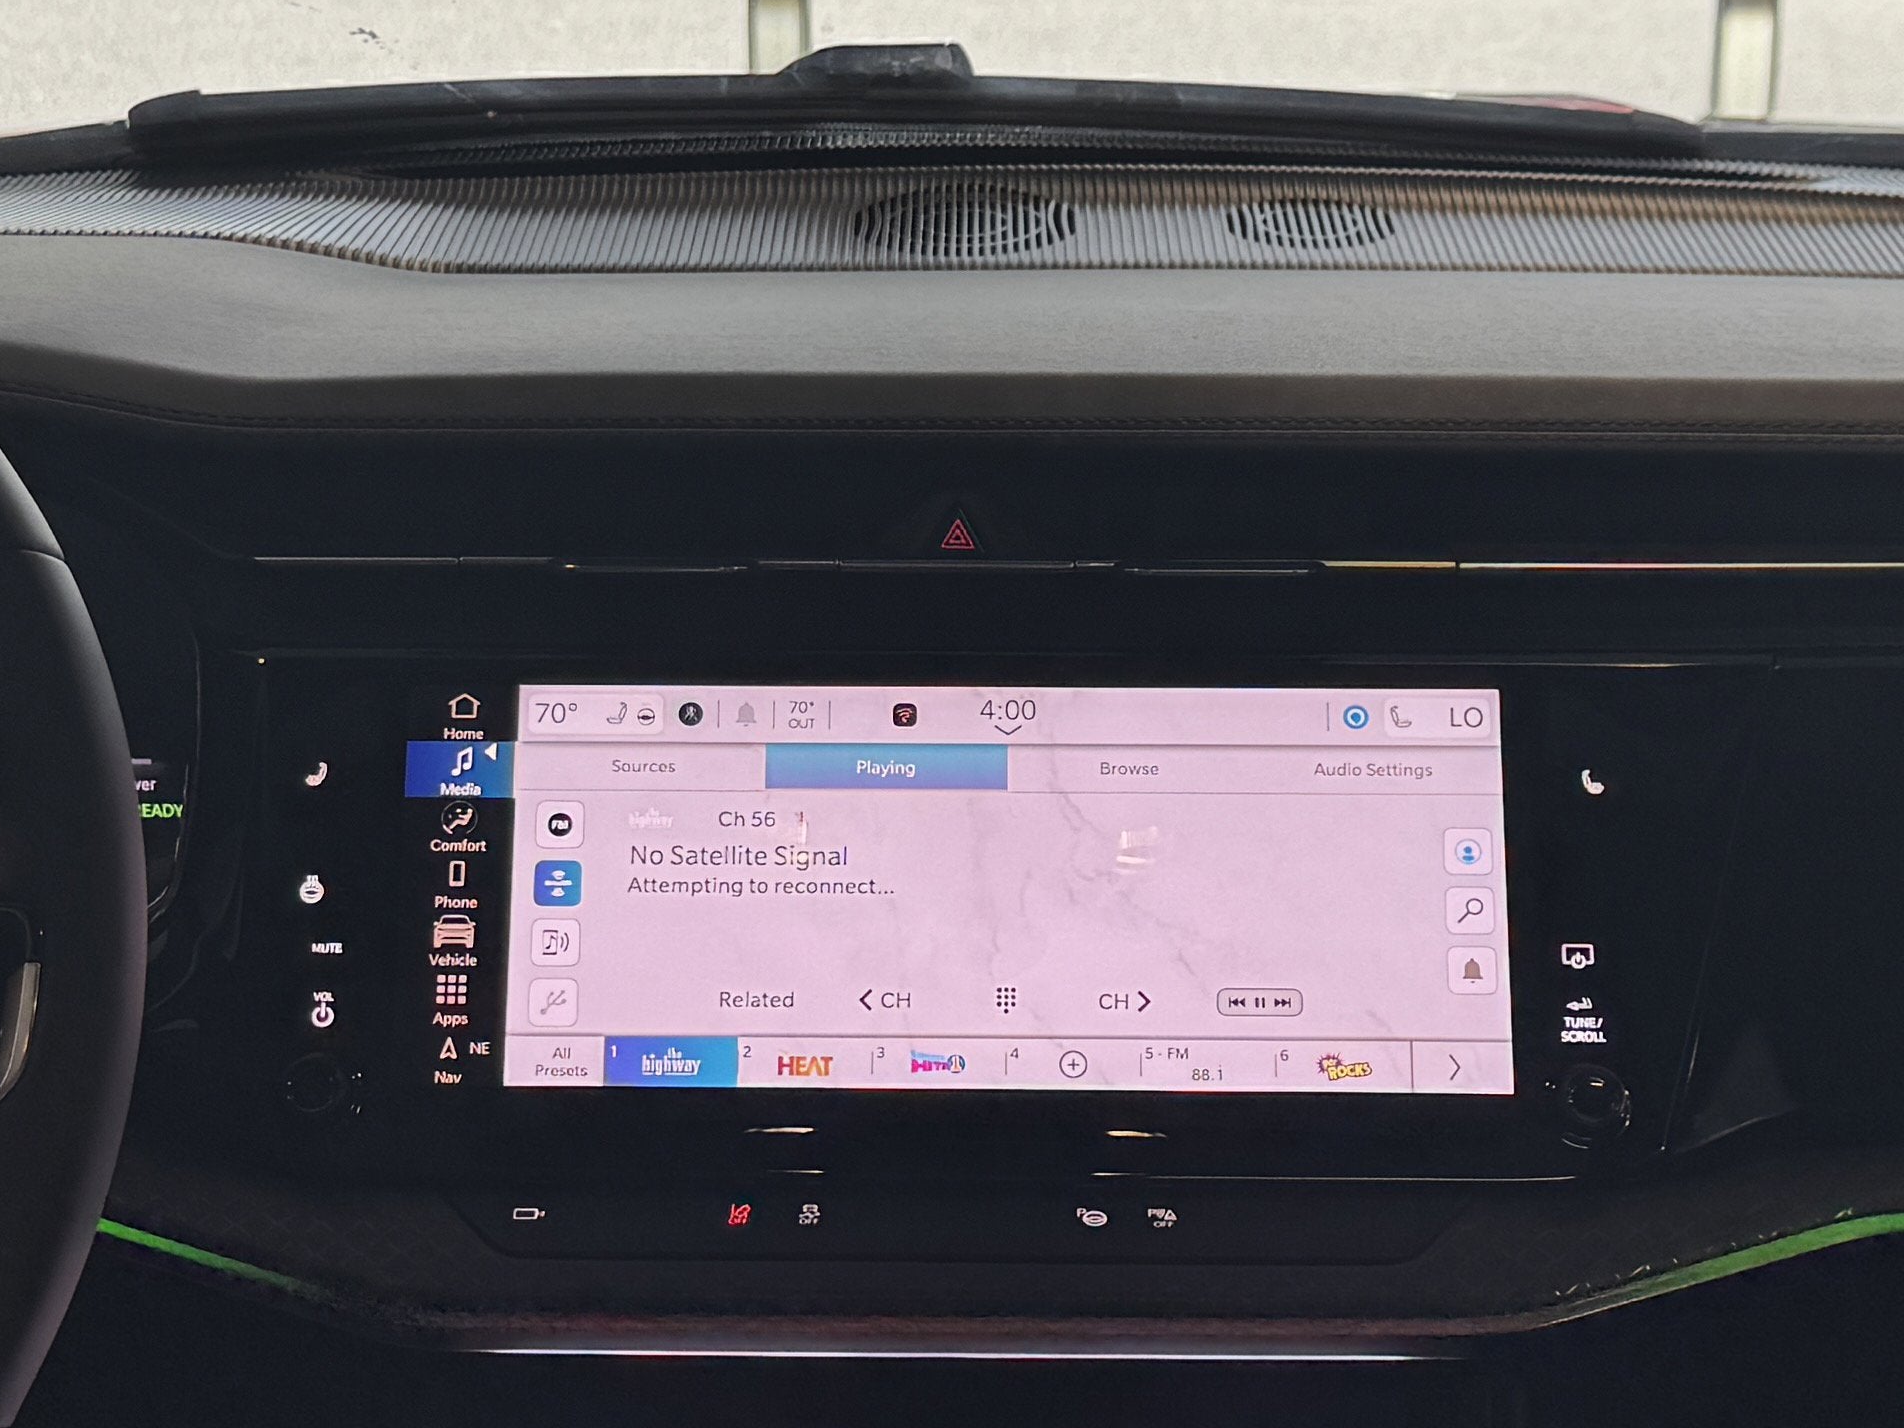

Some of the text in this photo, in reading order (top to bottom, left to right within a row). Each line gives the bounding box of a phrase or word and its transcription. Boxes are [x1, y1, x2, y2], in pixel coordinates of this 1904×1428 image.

[535, 702, 578, 724] 70°
[980, 698, 1038, 723] 4:00
[1450, 707, 1484, 729] LO
[788, 718, 815, 730] OUT
[443, 727, 484, 741] Home
[611, 759, 677, 774] Sources
[856, 760, 916, 778] Playing
[1099, 761, 1159, 776] Browse
[1314, 761, 1434, 780] Audio Settings
[440, 782, 482, 797] Media
[137, 803, 184, 818] EADY
[718, 811, 777, 827] Ch 56
[429, 838, 487, 853] Comfort
[630, 845, 848, 871] No Satellite Signal
[627, 876, 896, 898] Attempting to reconnect...
[434, 895, 478, 910] Phone
[311, 942, 344, 954] MUTE
[428, 953, 478, 967] Vehicle
[313, 991, 335, 1003] VOL
[719, 991, 795, 1009] Related
[880, 992, 911, 1009] CH
[1098, 993, 1129, 1010] CH
[432, 1011, 469, 1028] Apps
[1560, 1029, 1607, 1045] SCROLL
[469, 1041, 491, 1056] NE
[552, 1047, 571, 1060] All
[610, 1045, 618, 1058] 1
[742, 1045, 752, 1058] 2
[876, 1046, 886, 1059] 3
[1010, 1046, 1020, 1059] 4
[1167, 1047, 1189, 1060] FM
[1279, 1049, 1289, 1062] 6
[535, 1063, 588, 1077] Presets
[641, 1053, 701, 1076] highway
[777, 1056, 833, 1077] HEAT
[1191, 1063, 1224, 1081] 88.1
[1327, 1062, 1373, 1081] ROCKS
[434, 1070, 462, 1084] Nav
